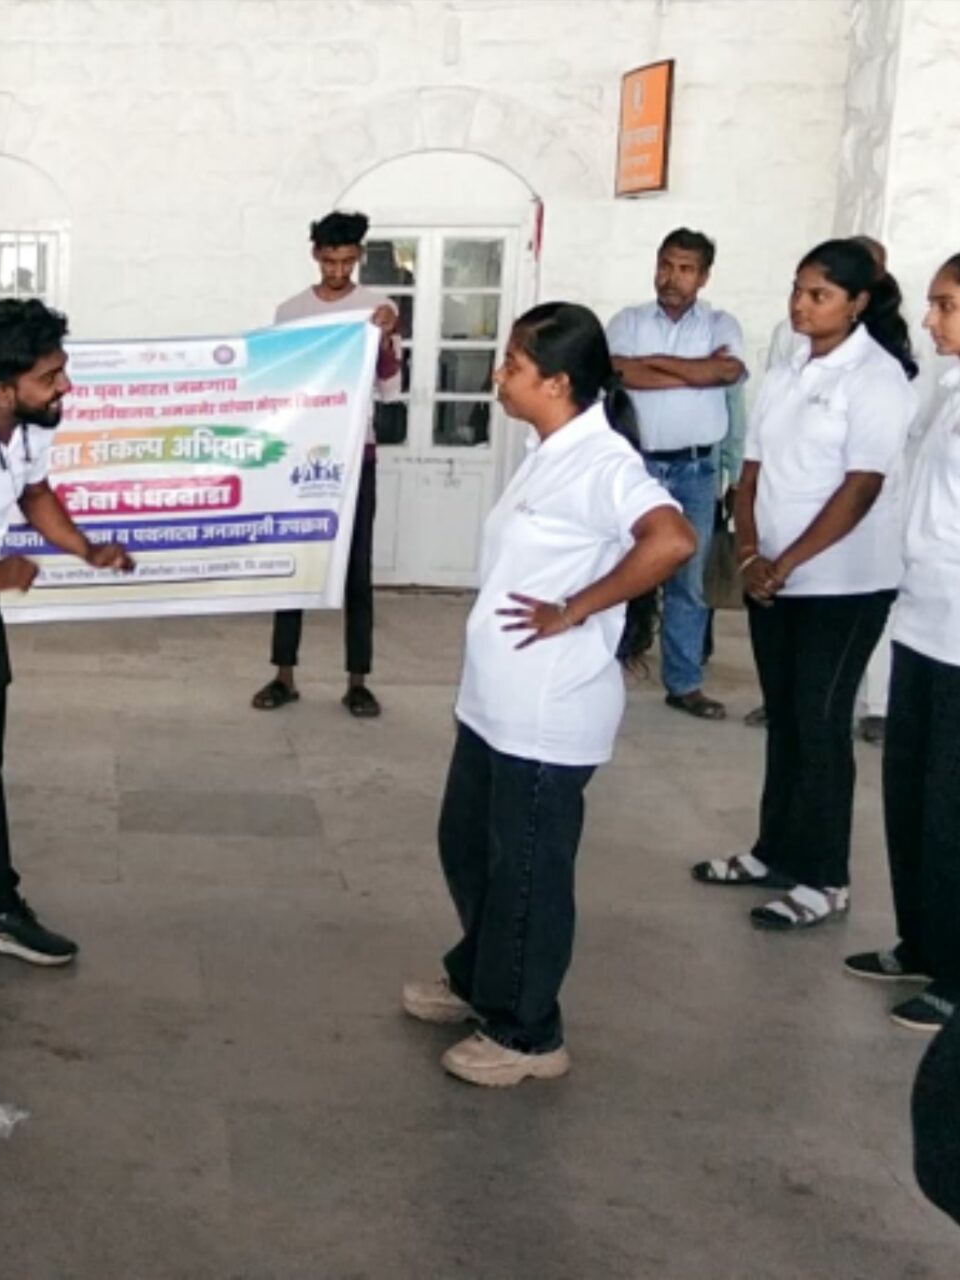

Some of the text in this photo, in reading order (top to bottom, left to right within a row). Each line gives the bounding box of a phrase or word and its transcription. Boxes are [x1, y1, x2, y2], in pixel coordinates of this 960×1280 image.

[89, 433, 166, 463] संकल्प
[171, 428, 264, 460] अभियान
[65, 482, 232, 511] सेवा पंधरवाडा
